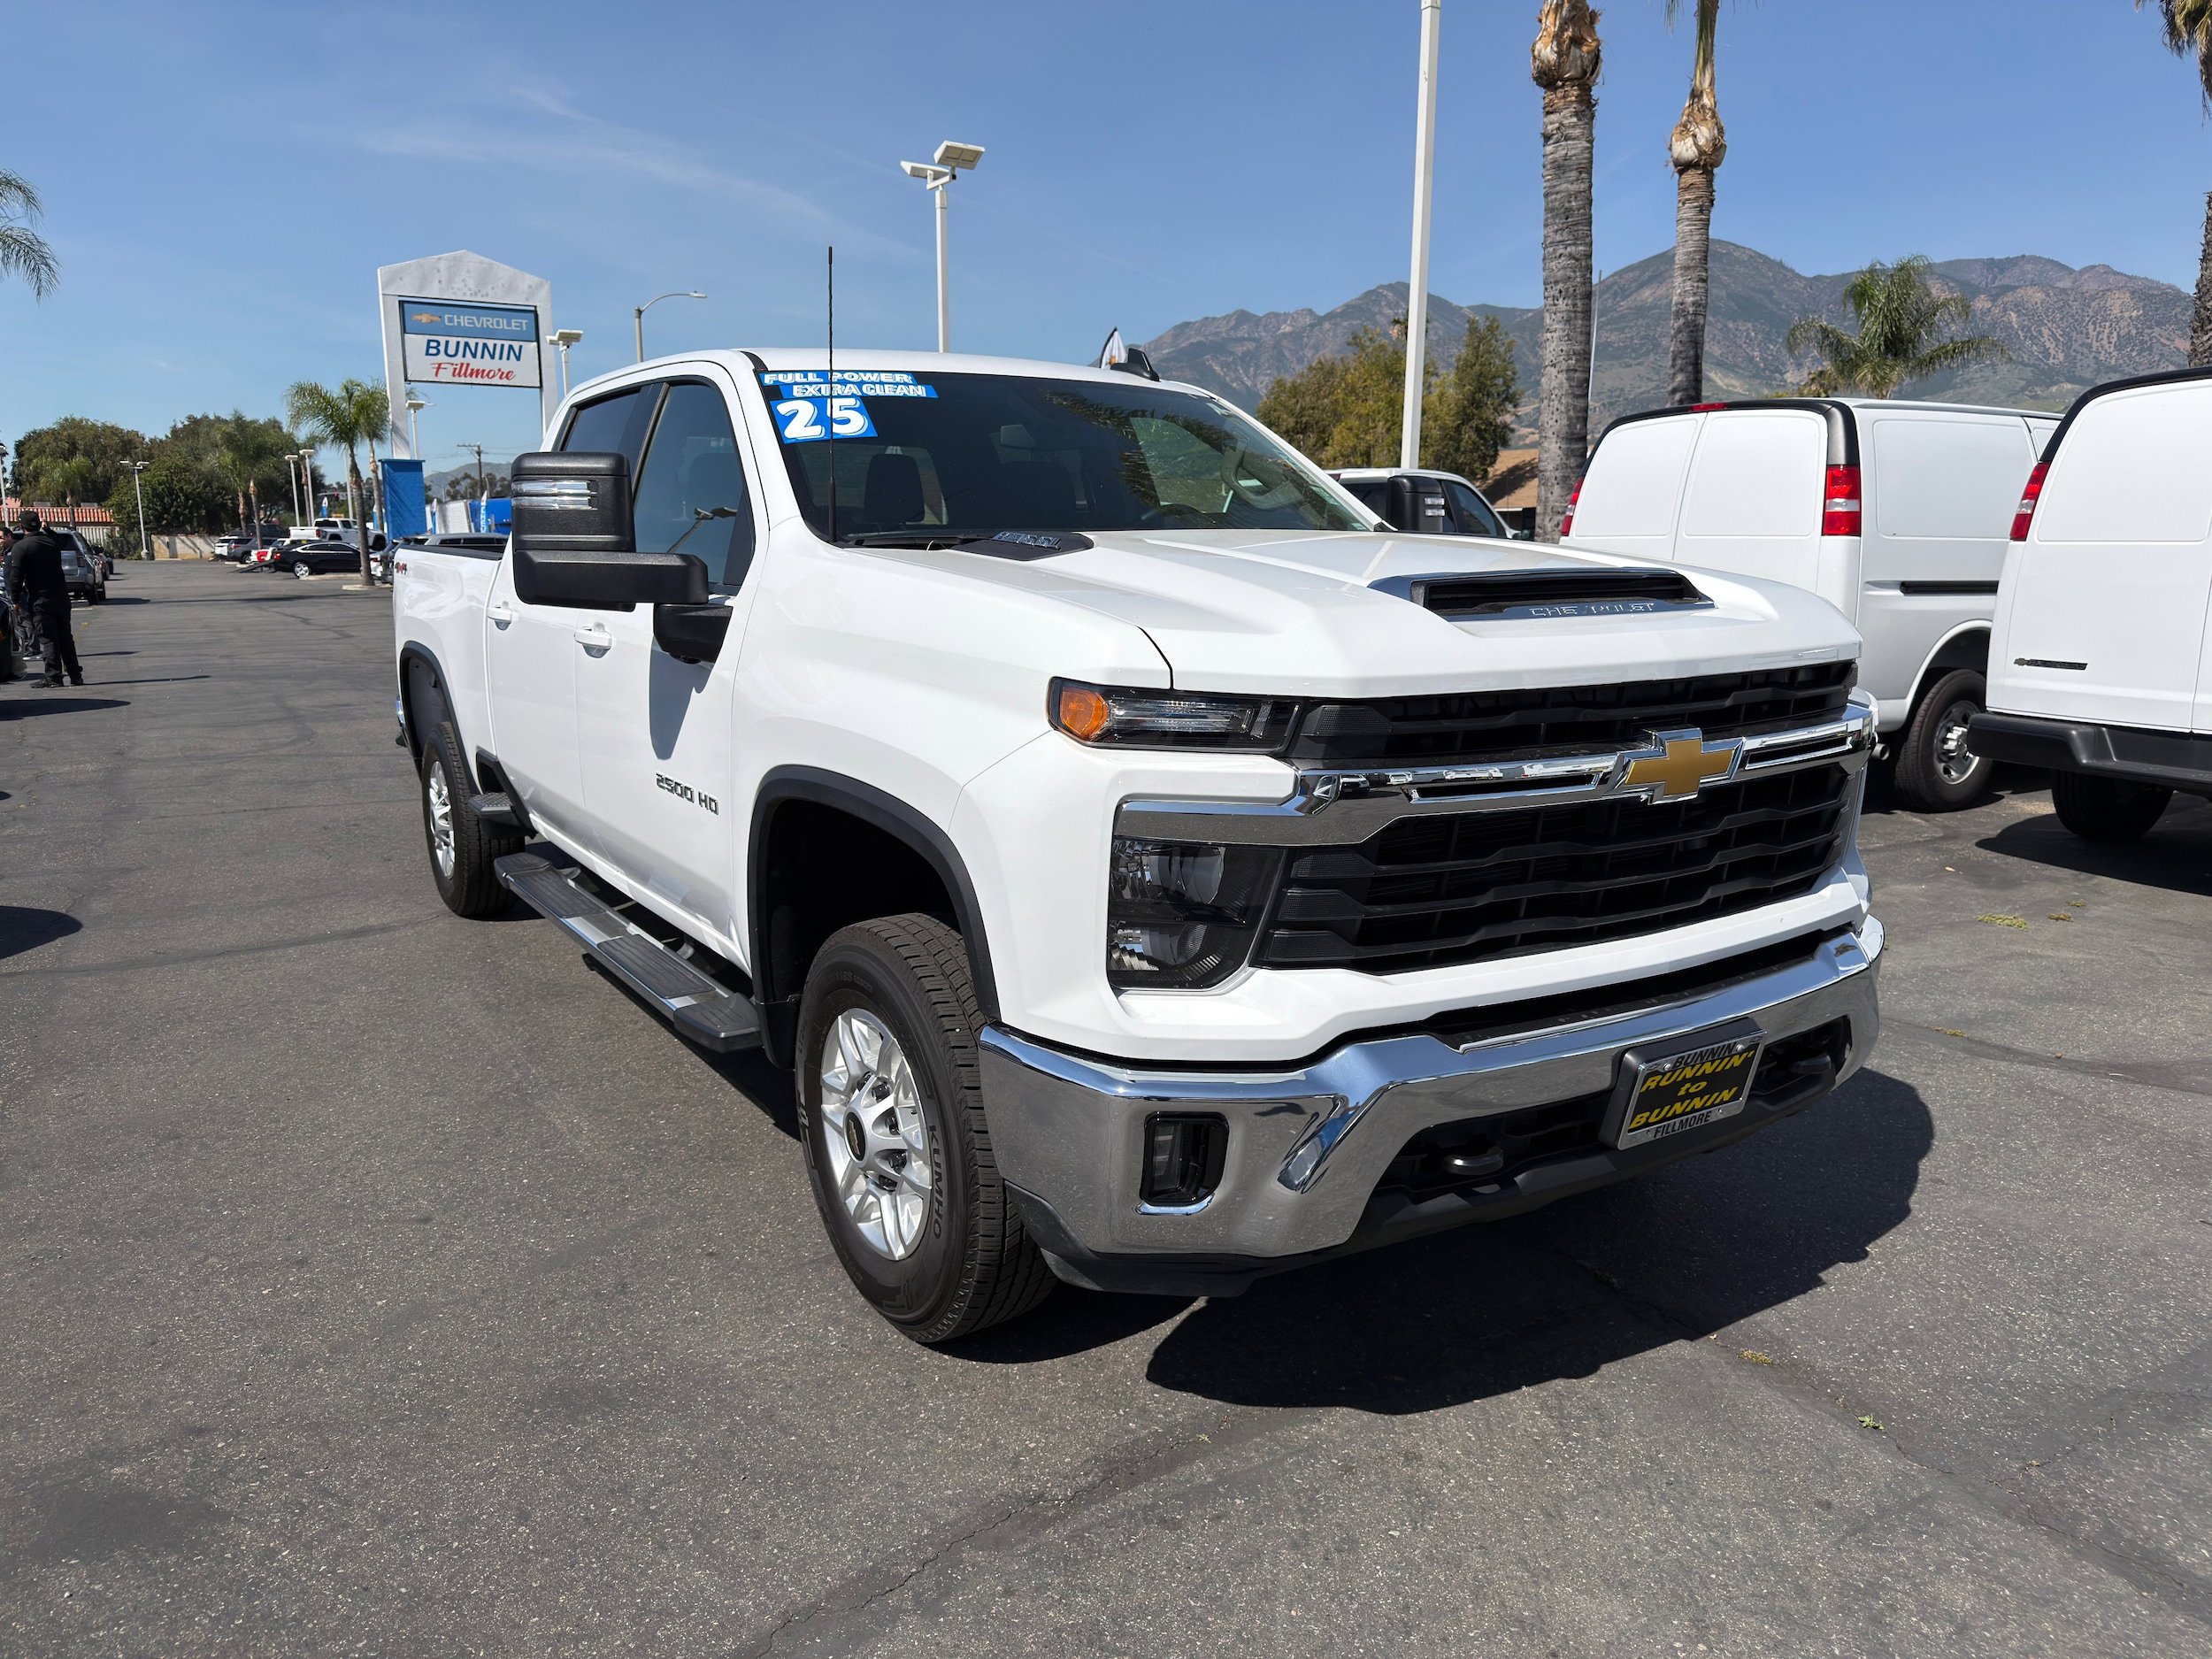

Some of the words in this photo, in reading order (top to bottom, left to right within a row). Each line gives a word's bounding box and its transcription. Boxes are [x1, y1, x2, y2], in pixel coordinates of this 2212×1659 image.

[444, 314, 528, 331] CHEVROLET
[425, 339, 523, 361] BUNNIN
[430, 362, 516, 380] Fillmore
[764, 373, 824, 384] FULL
[828, 373, 912, 383] POWER
[793, 384, 862, 396] EXTRA
[862, 384, 926, 396] CLEAN
[776, 398, 868, 440] 25
[1529, 603, 1655, 617] CHEROLET
[656, 772, 695, 803] 2500
[698, 790, 718, 815] HD
[1671, 1041, 1737, 1069] BUNNIN
[1640, 1050, 1755, 1093] RUNNIN'
[1677, 1080, 1708, 1096] to
[1628, 1087, 1739, 1130] BUNNIN
[1654, 1110, 1712, 1139] FILLMORE
[929, 1125, 943, 1240] KUMHO
